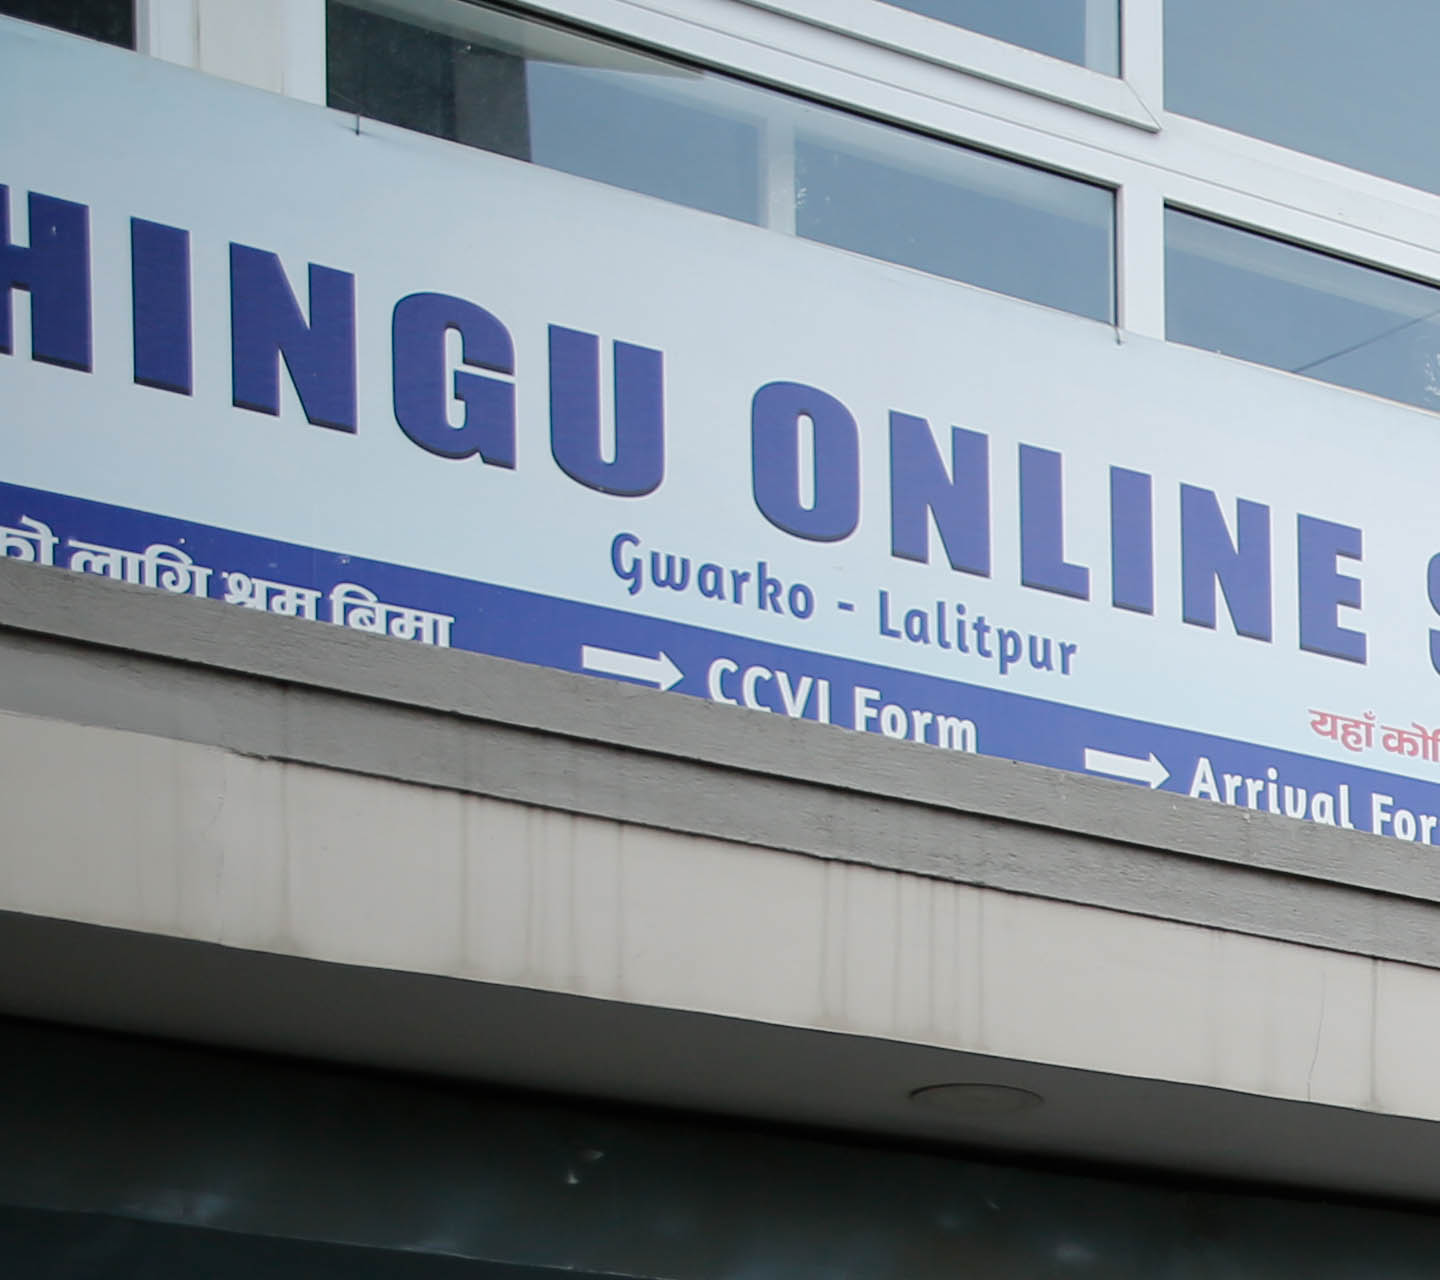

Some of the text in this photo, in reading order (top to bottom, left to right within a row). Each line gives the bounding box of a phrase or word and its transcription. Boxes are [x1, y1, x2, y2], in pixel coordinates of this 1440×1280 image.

[751, 381, 1367, 665] ONLINE
[610, 531, 815, 620] Gwarko
[877, 594, 1077, 679] Lalitpur
[854, 687, 978, 755] Form
[1309, 704, 1375, 753] यहाँ
[1188, 756, 1350, 829] Arrival
